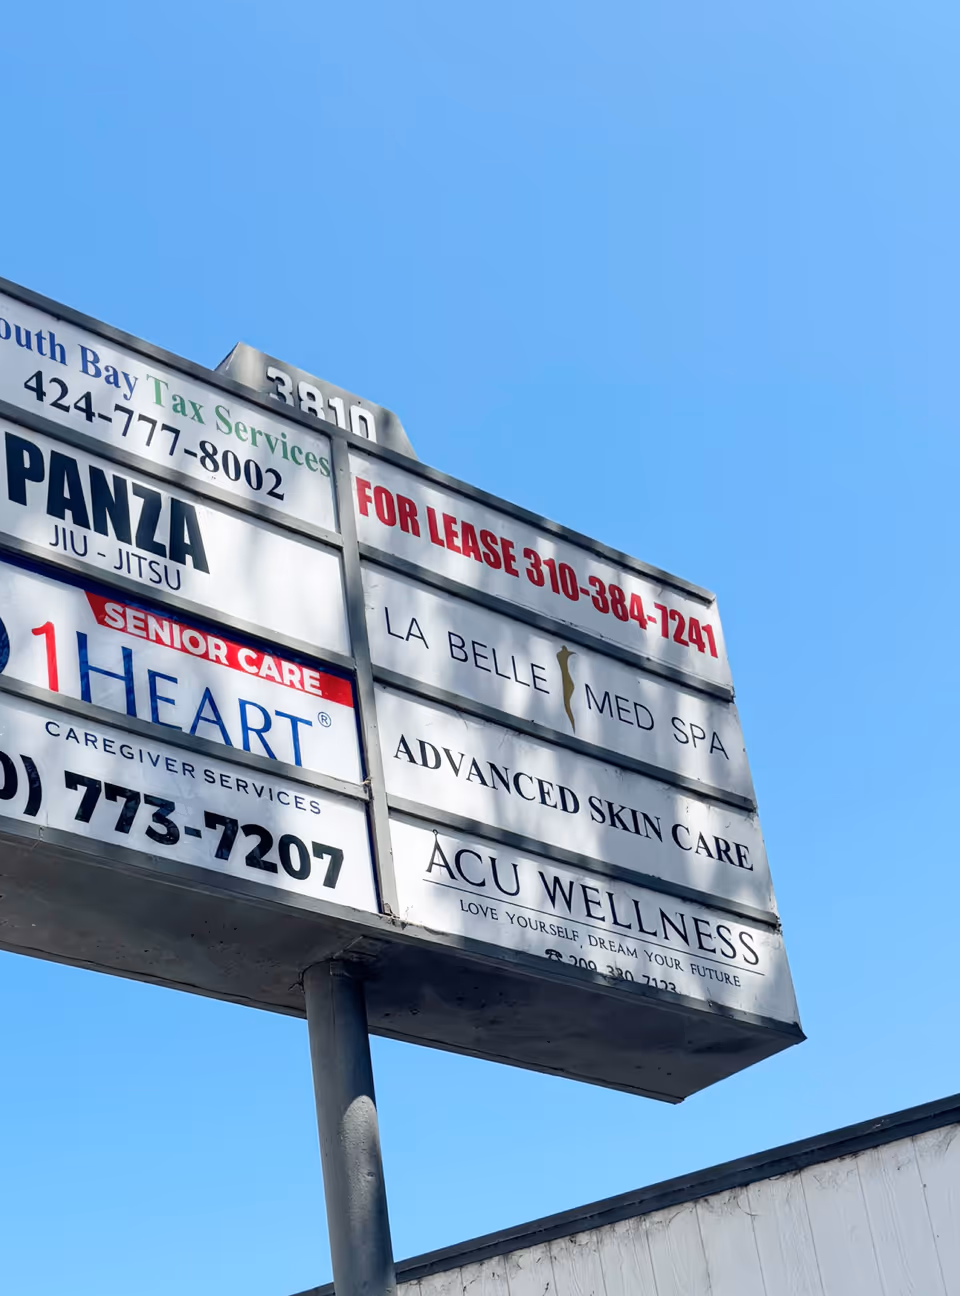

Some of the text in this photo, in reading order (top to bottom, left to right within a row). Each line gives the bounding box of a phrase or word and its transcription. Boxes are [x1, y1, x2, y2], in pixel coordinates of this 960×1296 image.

[22, 369, 286, 501] 424-777-8002
[77, 341, 139, 401] Bay
[146, 373, 207, 426] Tax
[214, 402, 332, 479] Services
[266, 366, 377, 444] 3810
[4, 430, 210, 575] PANZA
[48, 523, 88, 558] JIU
[112, 548, 182, 593] JITSU
[355, 476, 719, 659] FOR LEASE 310-384-7241
[103, 601, 324, 698] SENIOR CARE
[384, 606, 731, 761] LA BELLE MED SPA
[44, 720, 323, 816] CAREGIVER SERVICES
[64, 769, 344, 890] 773-7207
[392, 733, 755, 872] ADVANCED SKIN CARE
[425, 829, 761, 967] ACU WELLNESS
[459, 899, 742, 988] LOVE YOURSELF, DREAM YOUR FUTURE
